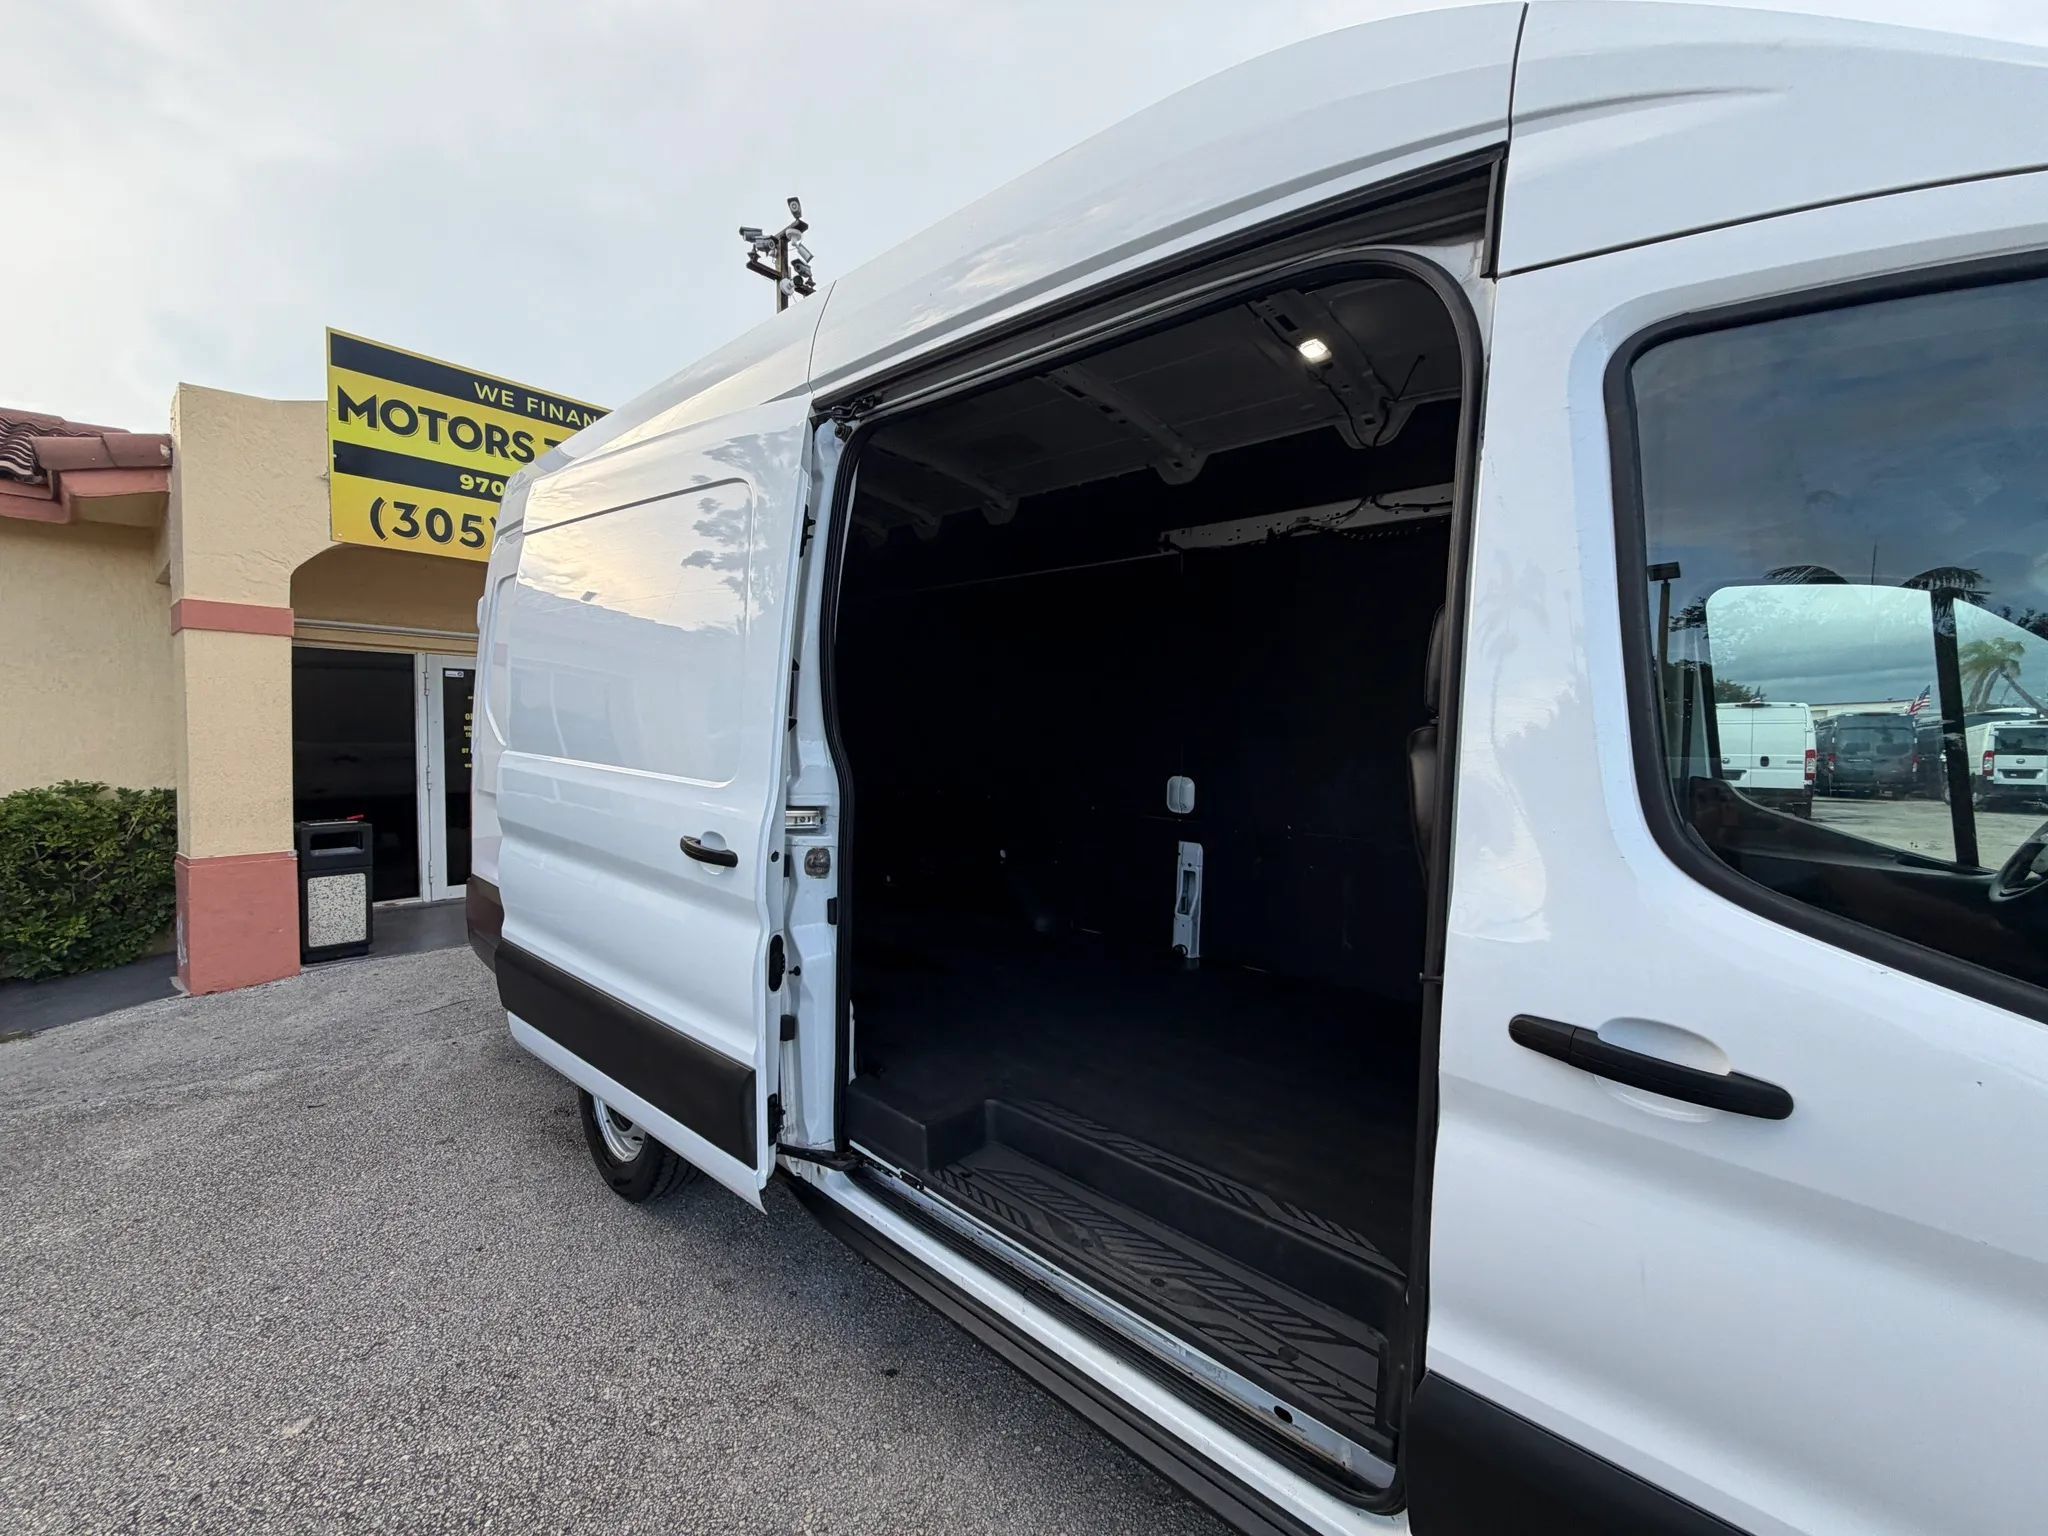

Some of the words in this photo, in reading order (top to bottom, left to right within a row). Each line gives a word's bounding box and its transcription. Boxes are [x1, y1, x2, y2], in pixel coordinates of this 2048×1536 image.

[473, 381, 514, 408] WE
[337, 384, 536, 465] MOTORS
[459, 474, 504, 497] 970
